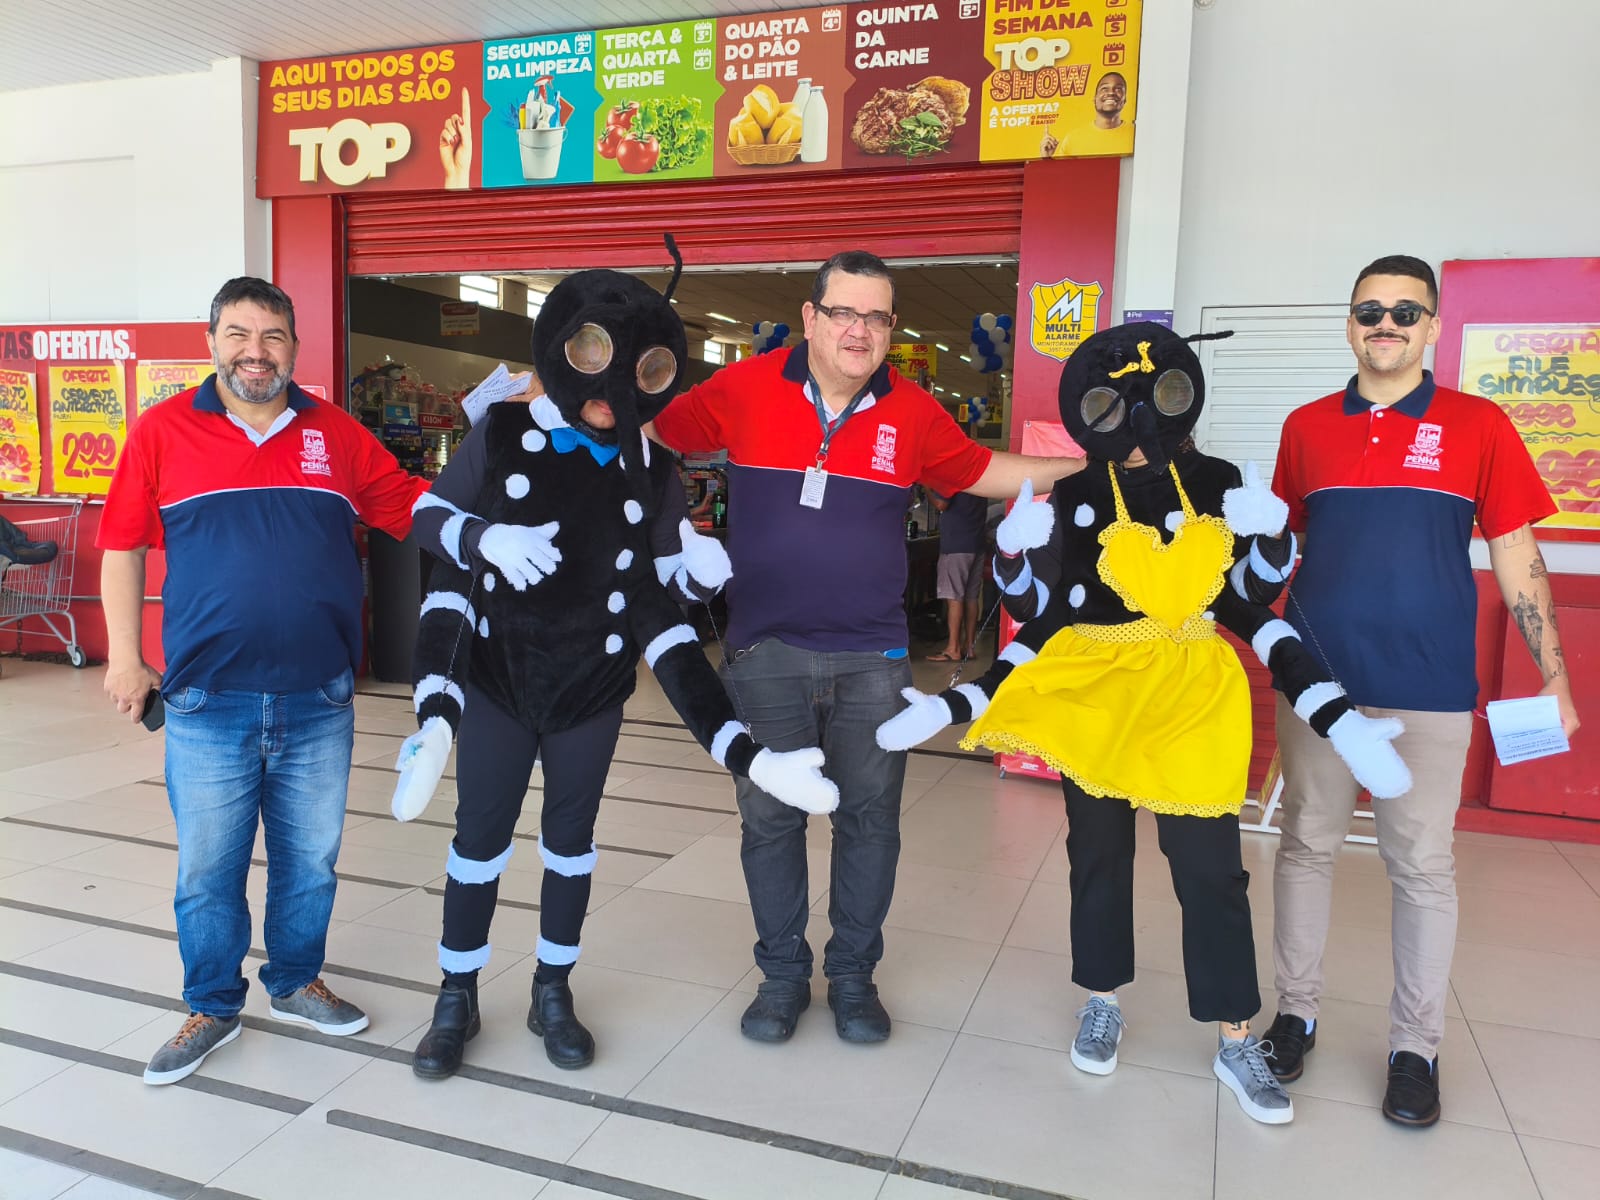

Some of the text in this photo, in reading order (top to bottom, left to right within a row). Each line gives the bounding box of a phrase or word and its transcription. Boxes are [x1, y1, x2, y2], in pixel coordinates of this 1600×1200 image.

[856, 3, 939, 27] QUINTA
[993, 11, 1093, 36] SEMANA
[602, 27, 683, 51] TERÇA &
[725, 17, 809, 40] QUARTA
[855, 30, 885, 48] DA
[1110, 22, 1120, 33] S
[486, 38, 571, 61] SEGUNDA
[602, 48, 681, 71] QUARTA
[724, 35, 800, 61] DO PÃO
[855, 47, 930, 70] CARNE
[994, 37, 1071, 72] TOP
[1108, 52, 1119, 63] D
[270, 49, 455, 88] AQUI TODOS OS
[487, 56, 592, 80] DA LIMPEZA
[602, 69, 665, 90] VERDE
[724, 60, 798, 82] & LEITE
[272, 73, 451, 113] SEUS DIAS SÃO
[990, 64, 1091, 102] SHOW
[990, 102, 1060, 116] A OFERTA?
[989, 115, 1030, 128] É TOP!
[288, 118, 412, 186] TOP
[1045, 323, 1080, 333] MULTI
[33, 329, 136, 360] OFERTAS.
[1495, 332, 1599, 354] OFERTA
[301, 461, 330, 471] PENHA
[1404, 455, 1440, 467] PENHA
